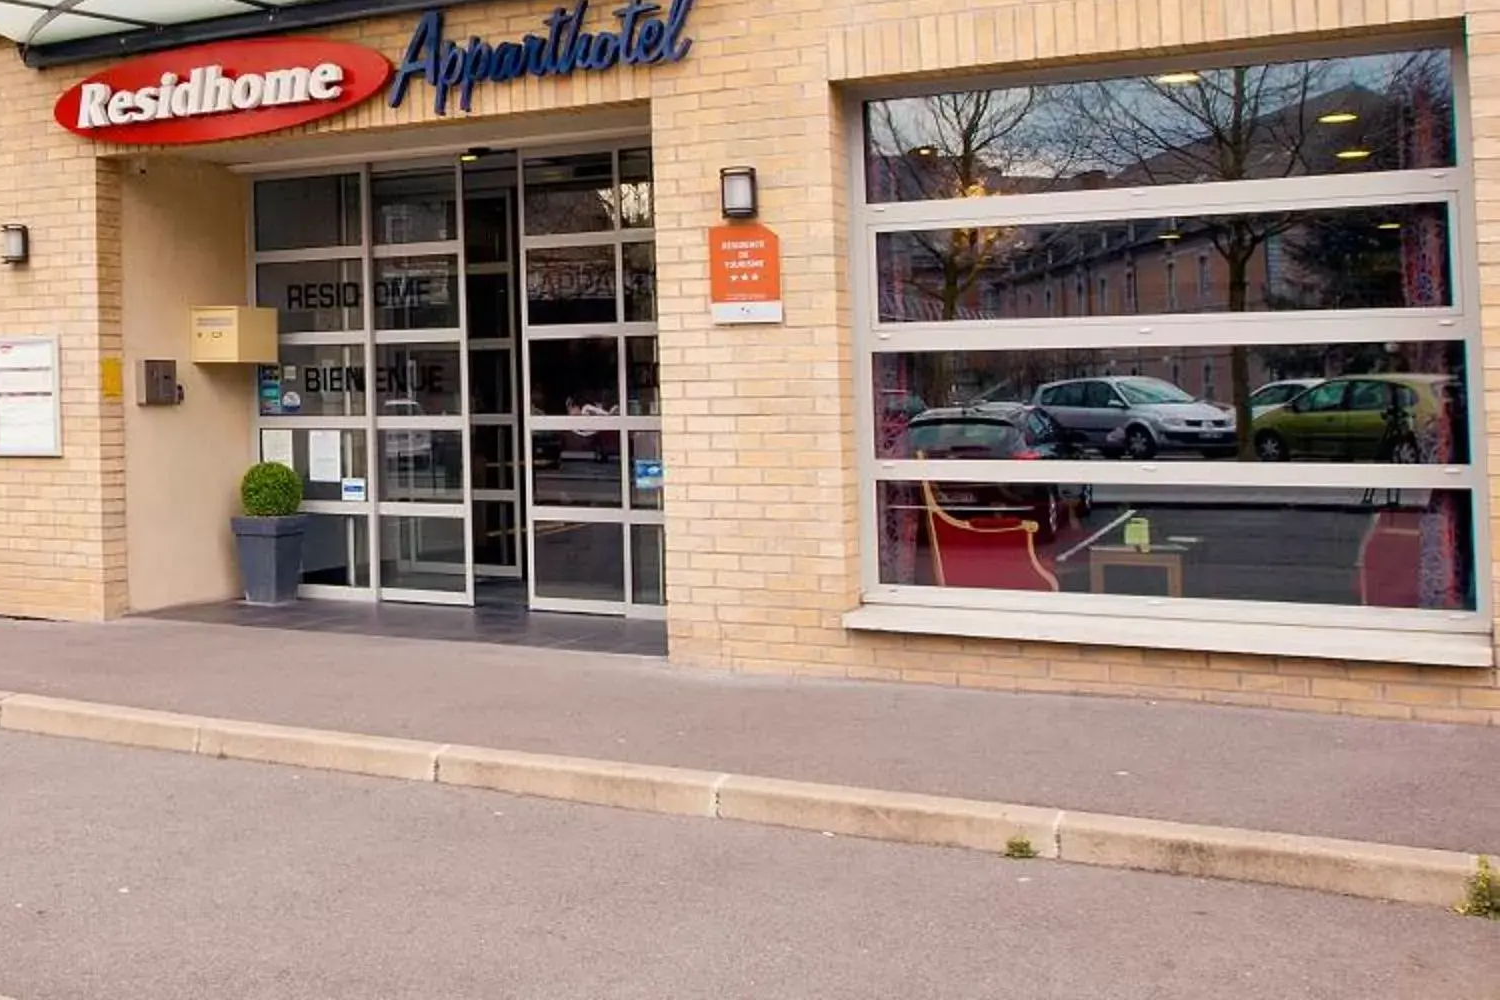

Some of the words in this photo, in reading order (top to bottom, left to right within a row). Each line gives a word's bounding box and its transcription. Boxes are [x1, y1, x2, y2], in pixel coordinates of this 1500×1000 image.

[77, 63, 343, 128] Residhome
[287, 280, 431, 309] RESIDOME
[304, 365, 444, 393] BIENENUE
